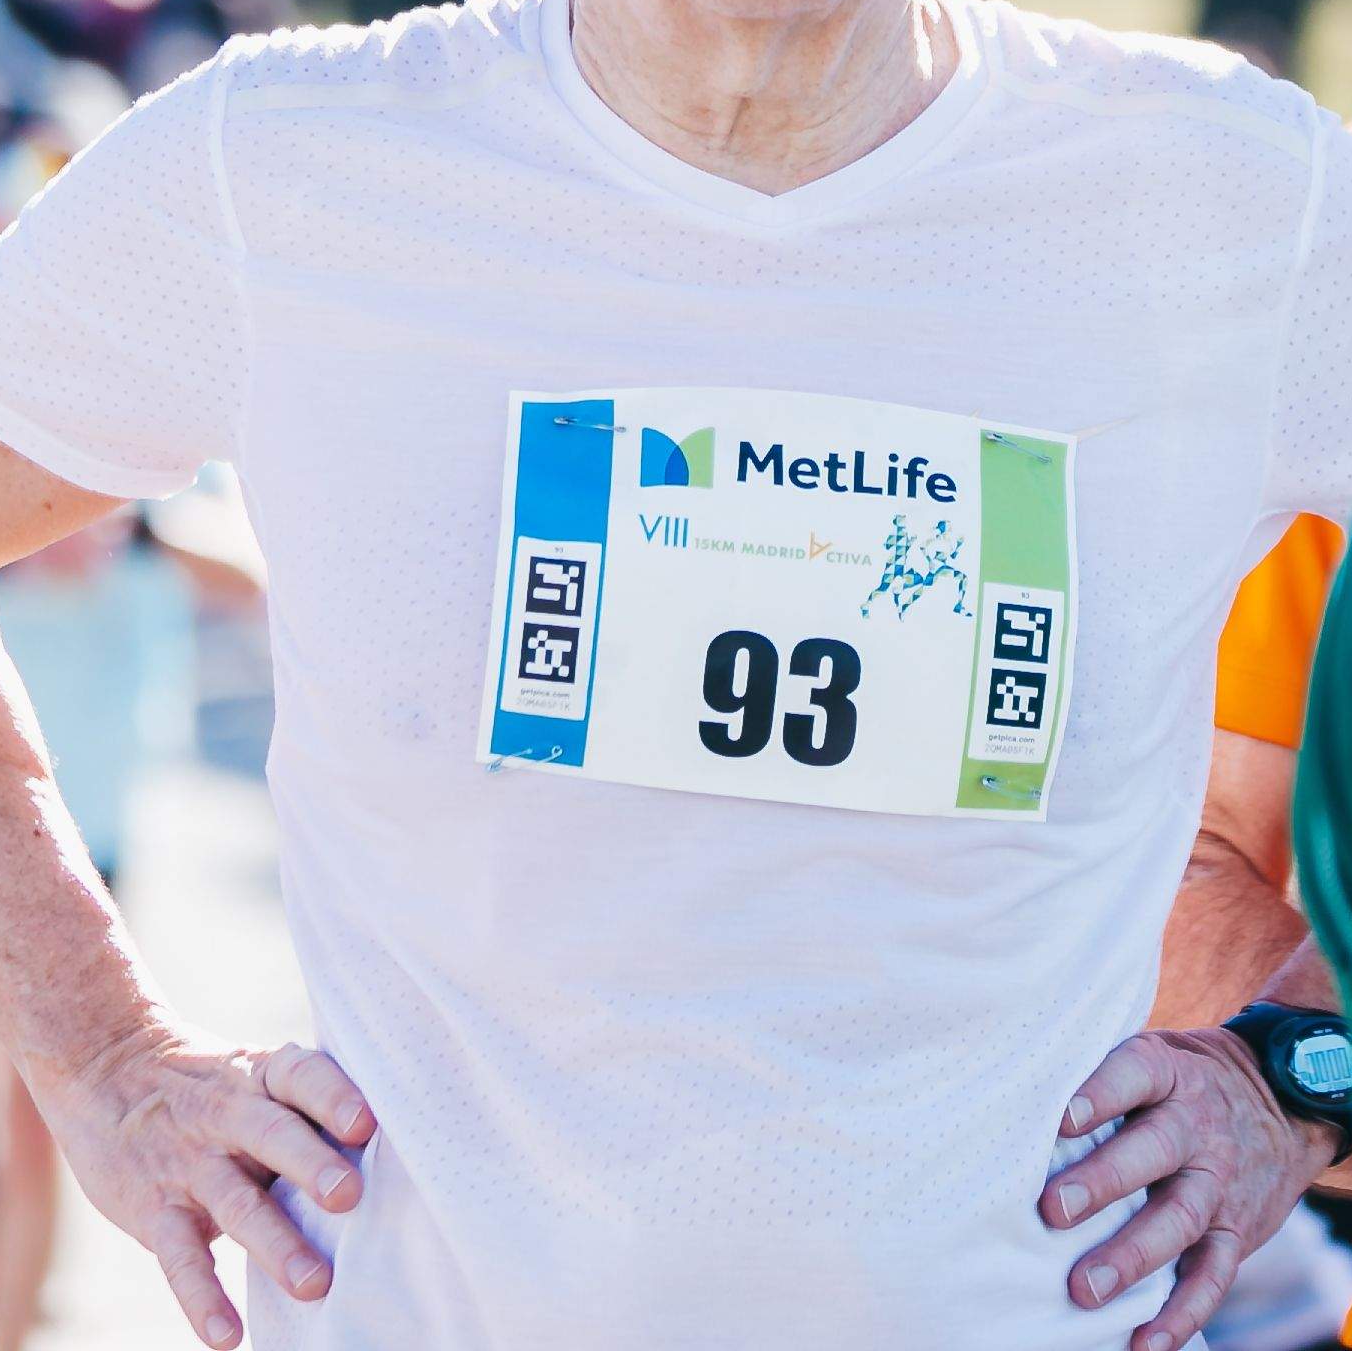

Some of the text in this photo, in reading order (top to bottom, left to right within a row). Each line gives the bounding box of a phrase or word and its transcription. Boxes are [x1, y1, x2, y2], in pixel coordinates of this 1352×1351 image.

[736, 441, 957, 503] MetLife
[639, 513, 690, 549] VIII
[694, 537, 736, 554] 15KM
[740, 541, 807, 561] MADRID
[698, 629, 862, 768] 93
